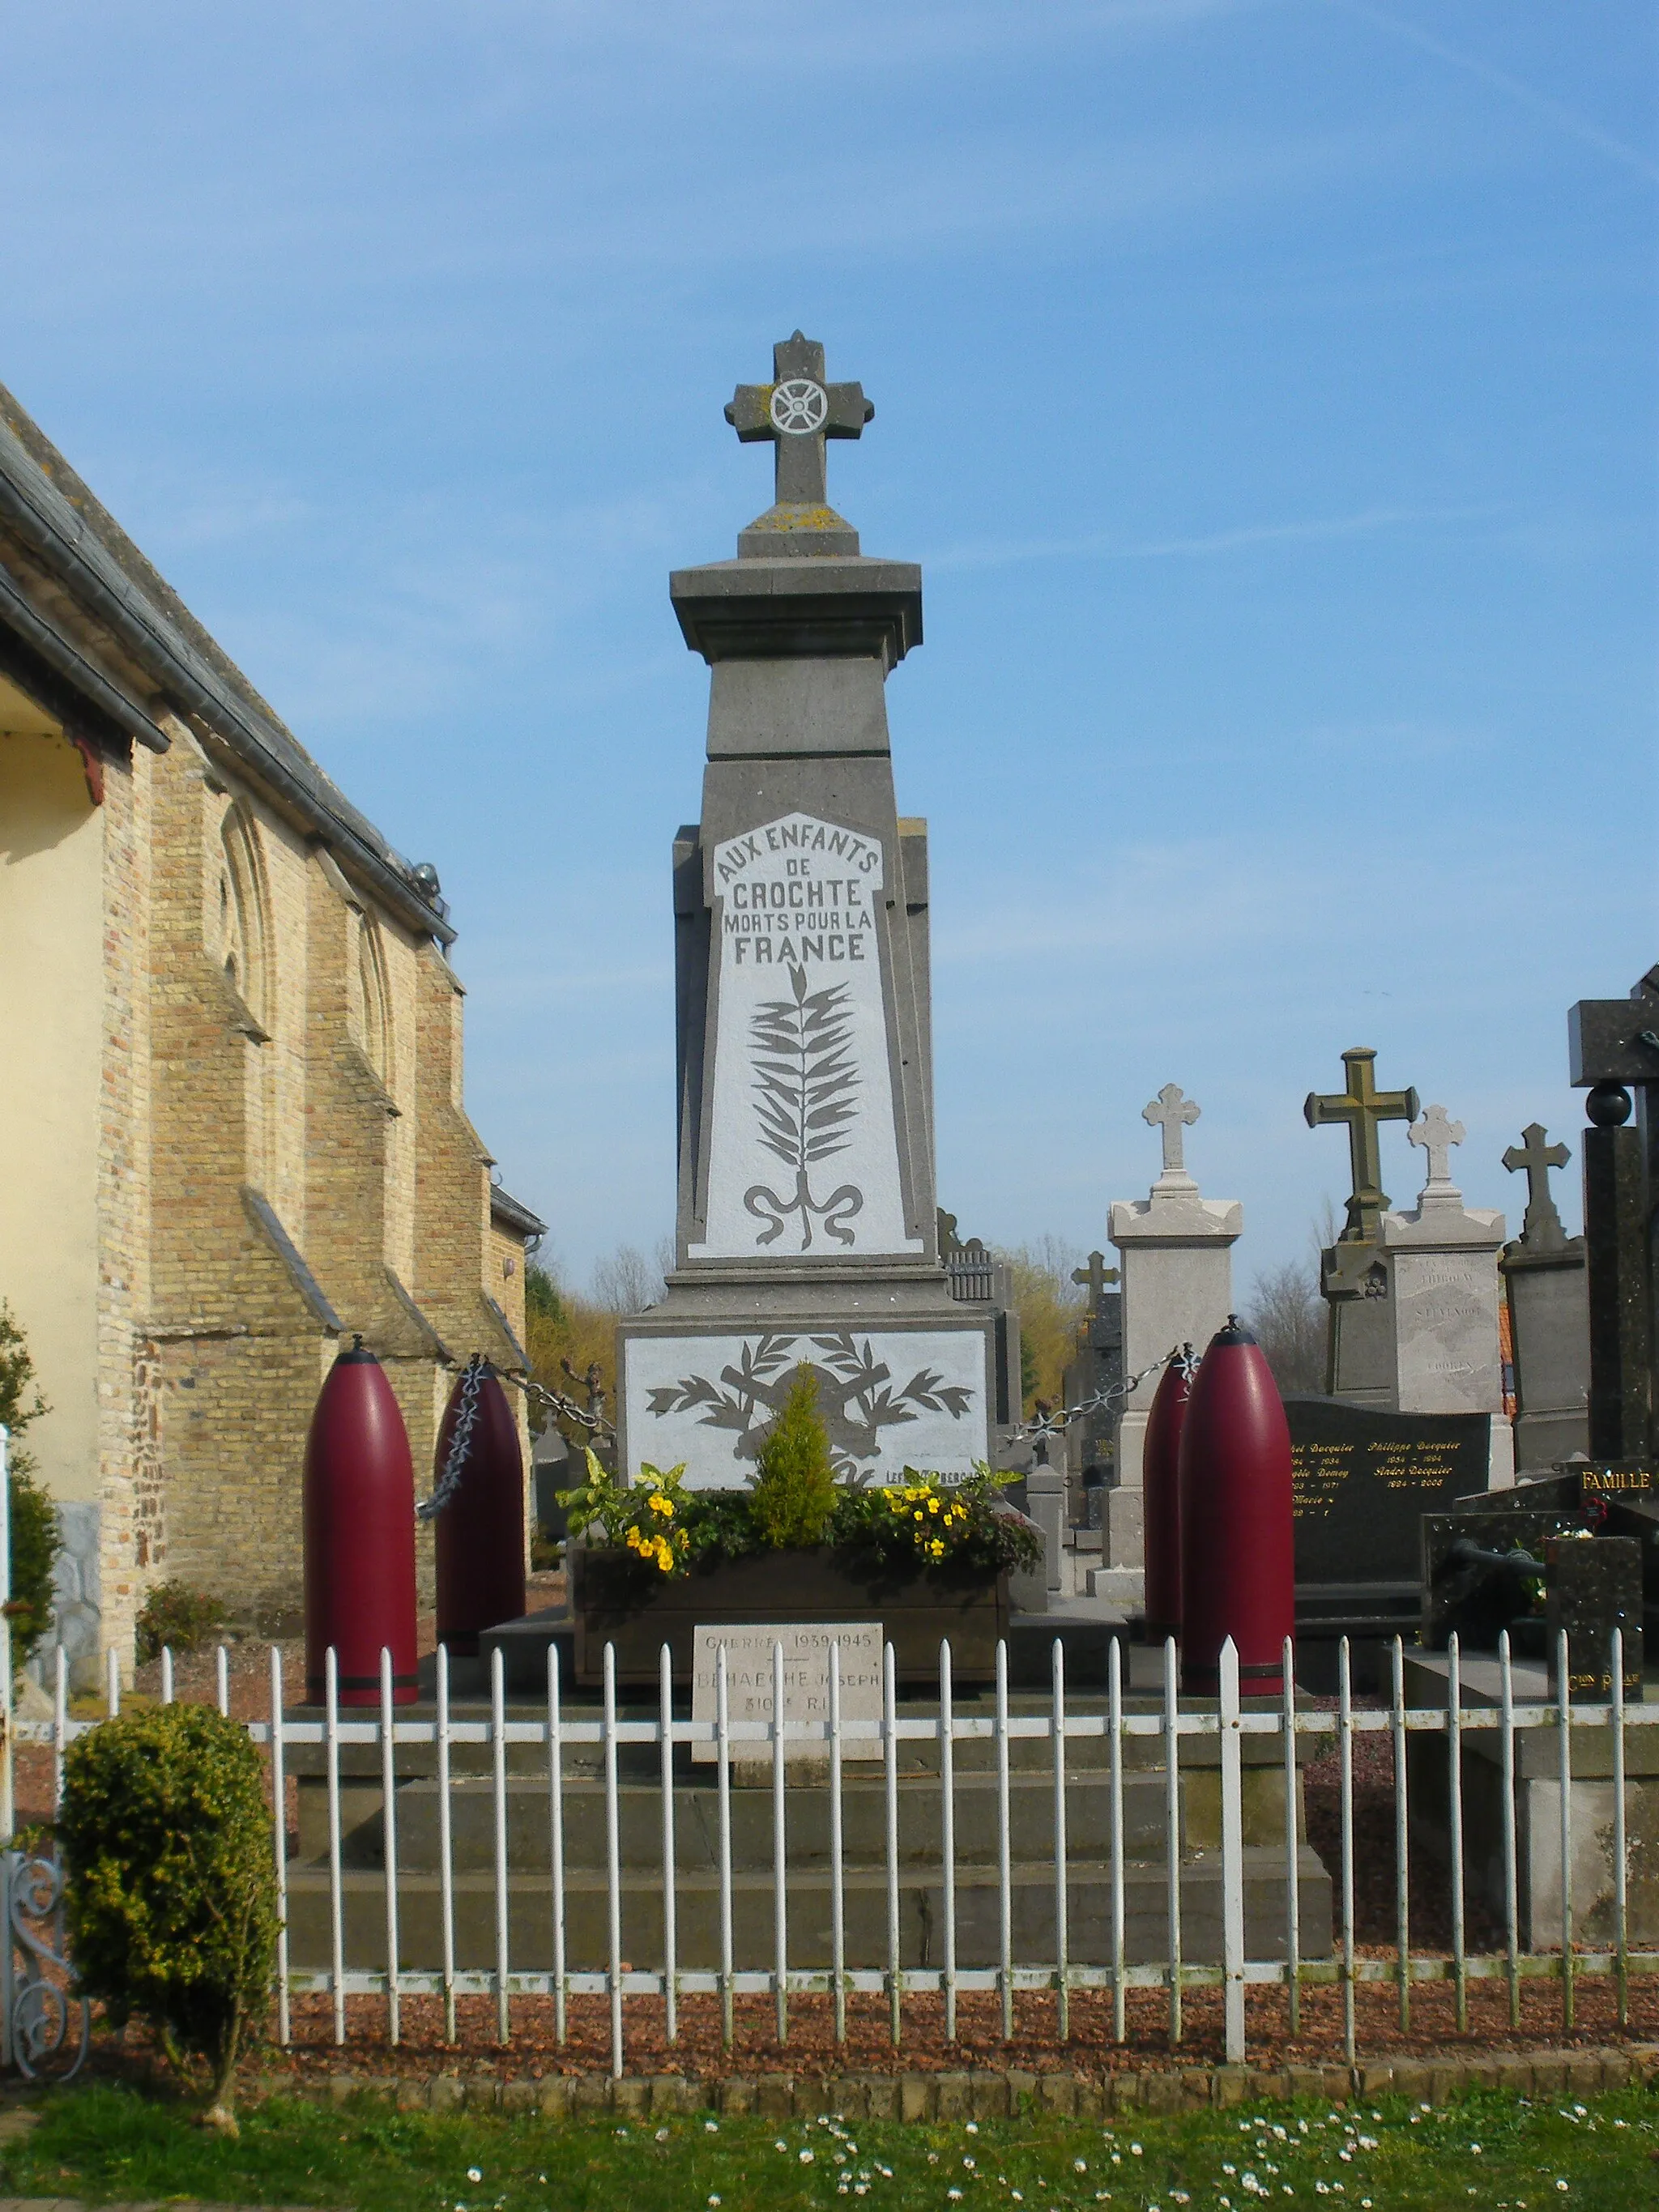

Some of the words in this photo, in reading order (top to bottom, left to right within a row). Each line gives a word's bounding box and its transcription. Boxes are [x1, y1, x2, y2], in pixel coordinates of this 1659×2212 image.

[717, 836, 762, 884] AUX
[765, 824, 879, 873] ENFANTS
[786, 858, 810, 876] DE
[732, 879, 862, 910] CROCHTE
[723, 913, 789, 934] MORTS
[795, 911, 840, 931] POUR
[845, 910, 872, 930] LA
[734, 933, 865, 964] FRANCE
[1367, 1442, 1412, 1452] Philippe
[1582, 1471, 1650, 1490] FAMILLE
[706, 1636, 774, 1650] GUERRE
[795, 1634, 830, 1648] 1939
[838, 1633, 872, 1647] 1945
